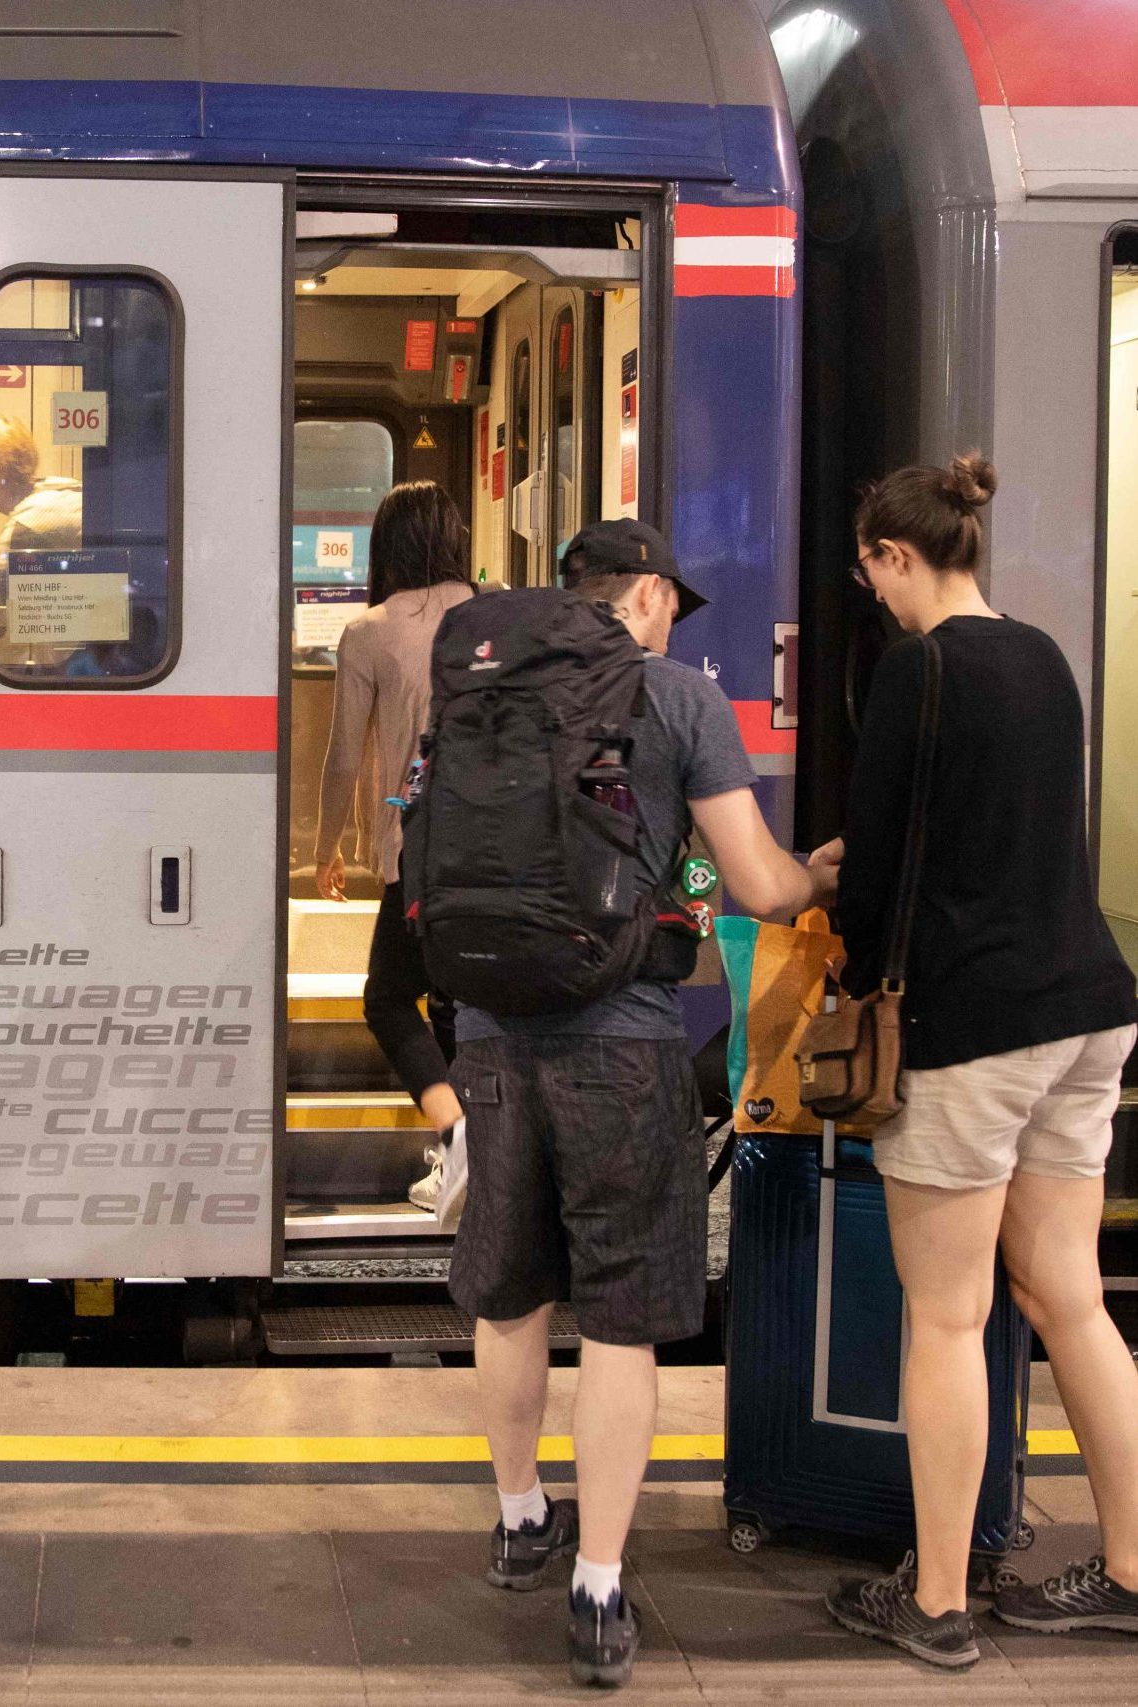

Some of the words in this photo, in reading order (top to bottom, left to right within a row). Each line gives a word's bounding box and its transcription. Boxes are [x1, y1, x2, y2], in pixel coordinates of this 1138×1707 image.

[58, 408, 100, 429] 306
[322, 542, 348, 557] 306
[17, 583, 42, 592] WIEN
[44, 582, 62, 591] HBF
[18, 622, 51, 633] ZÜRICH
[53, 624, 67, 633] HB
[43, 1108, 273, 1135] cucce
